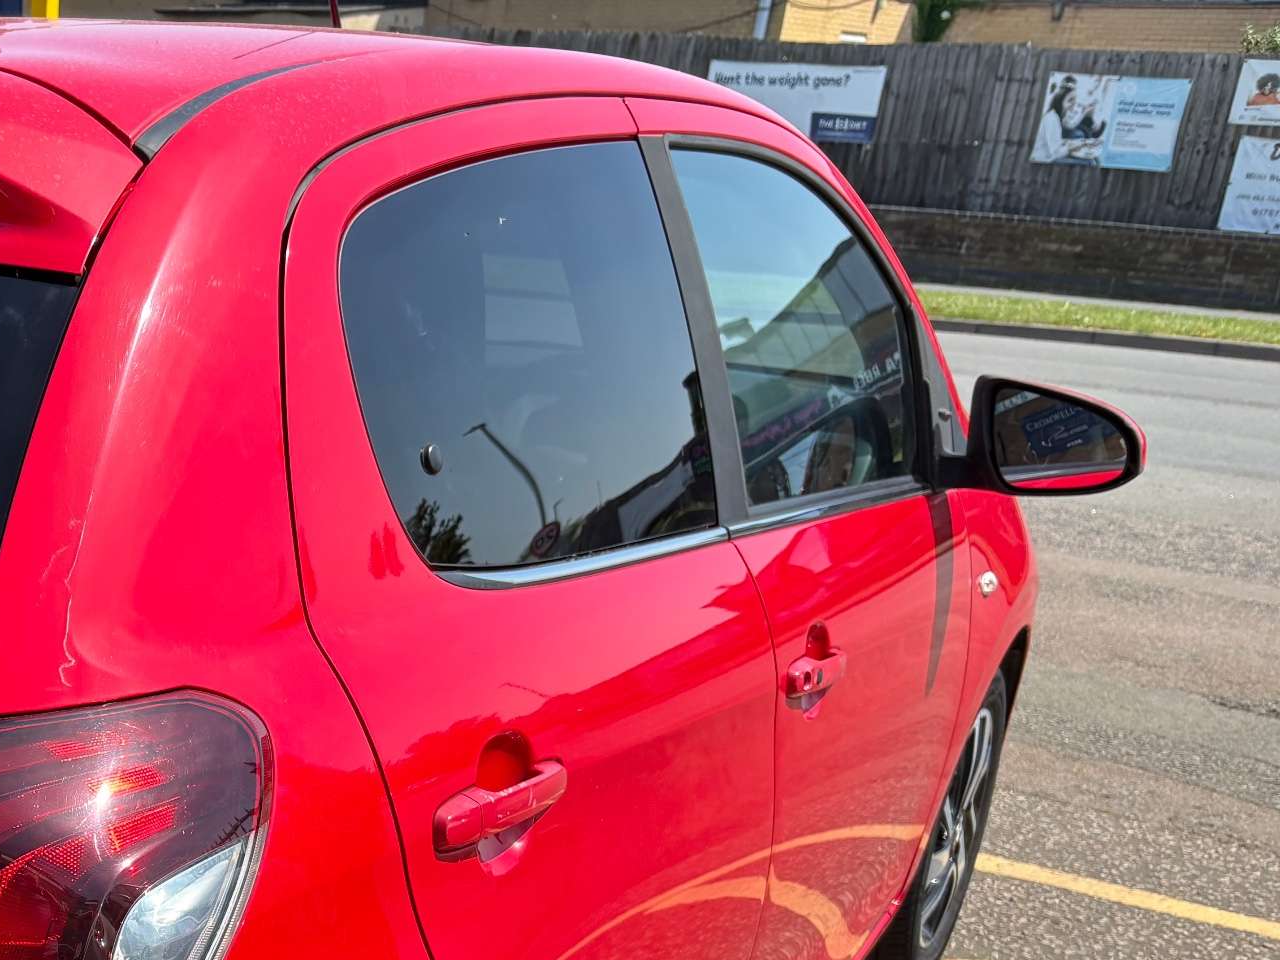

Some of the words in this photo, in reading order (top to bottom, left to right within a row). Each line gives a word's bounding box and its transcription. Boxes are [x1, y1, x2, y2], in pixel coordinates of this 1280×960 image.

[744, 73, 765, 86] the
[768, 72, 809, 89] weight
[813, 74, 851, 89] gone?
